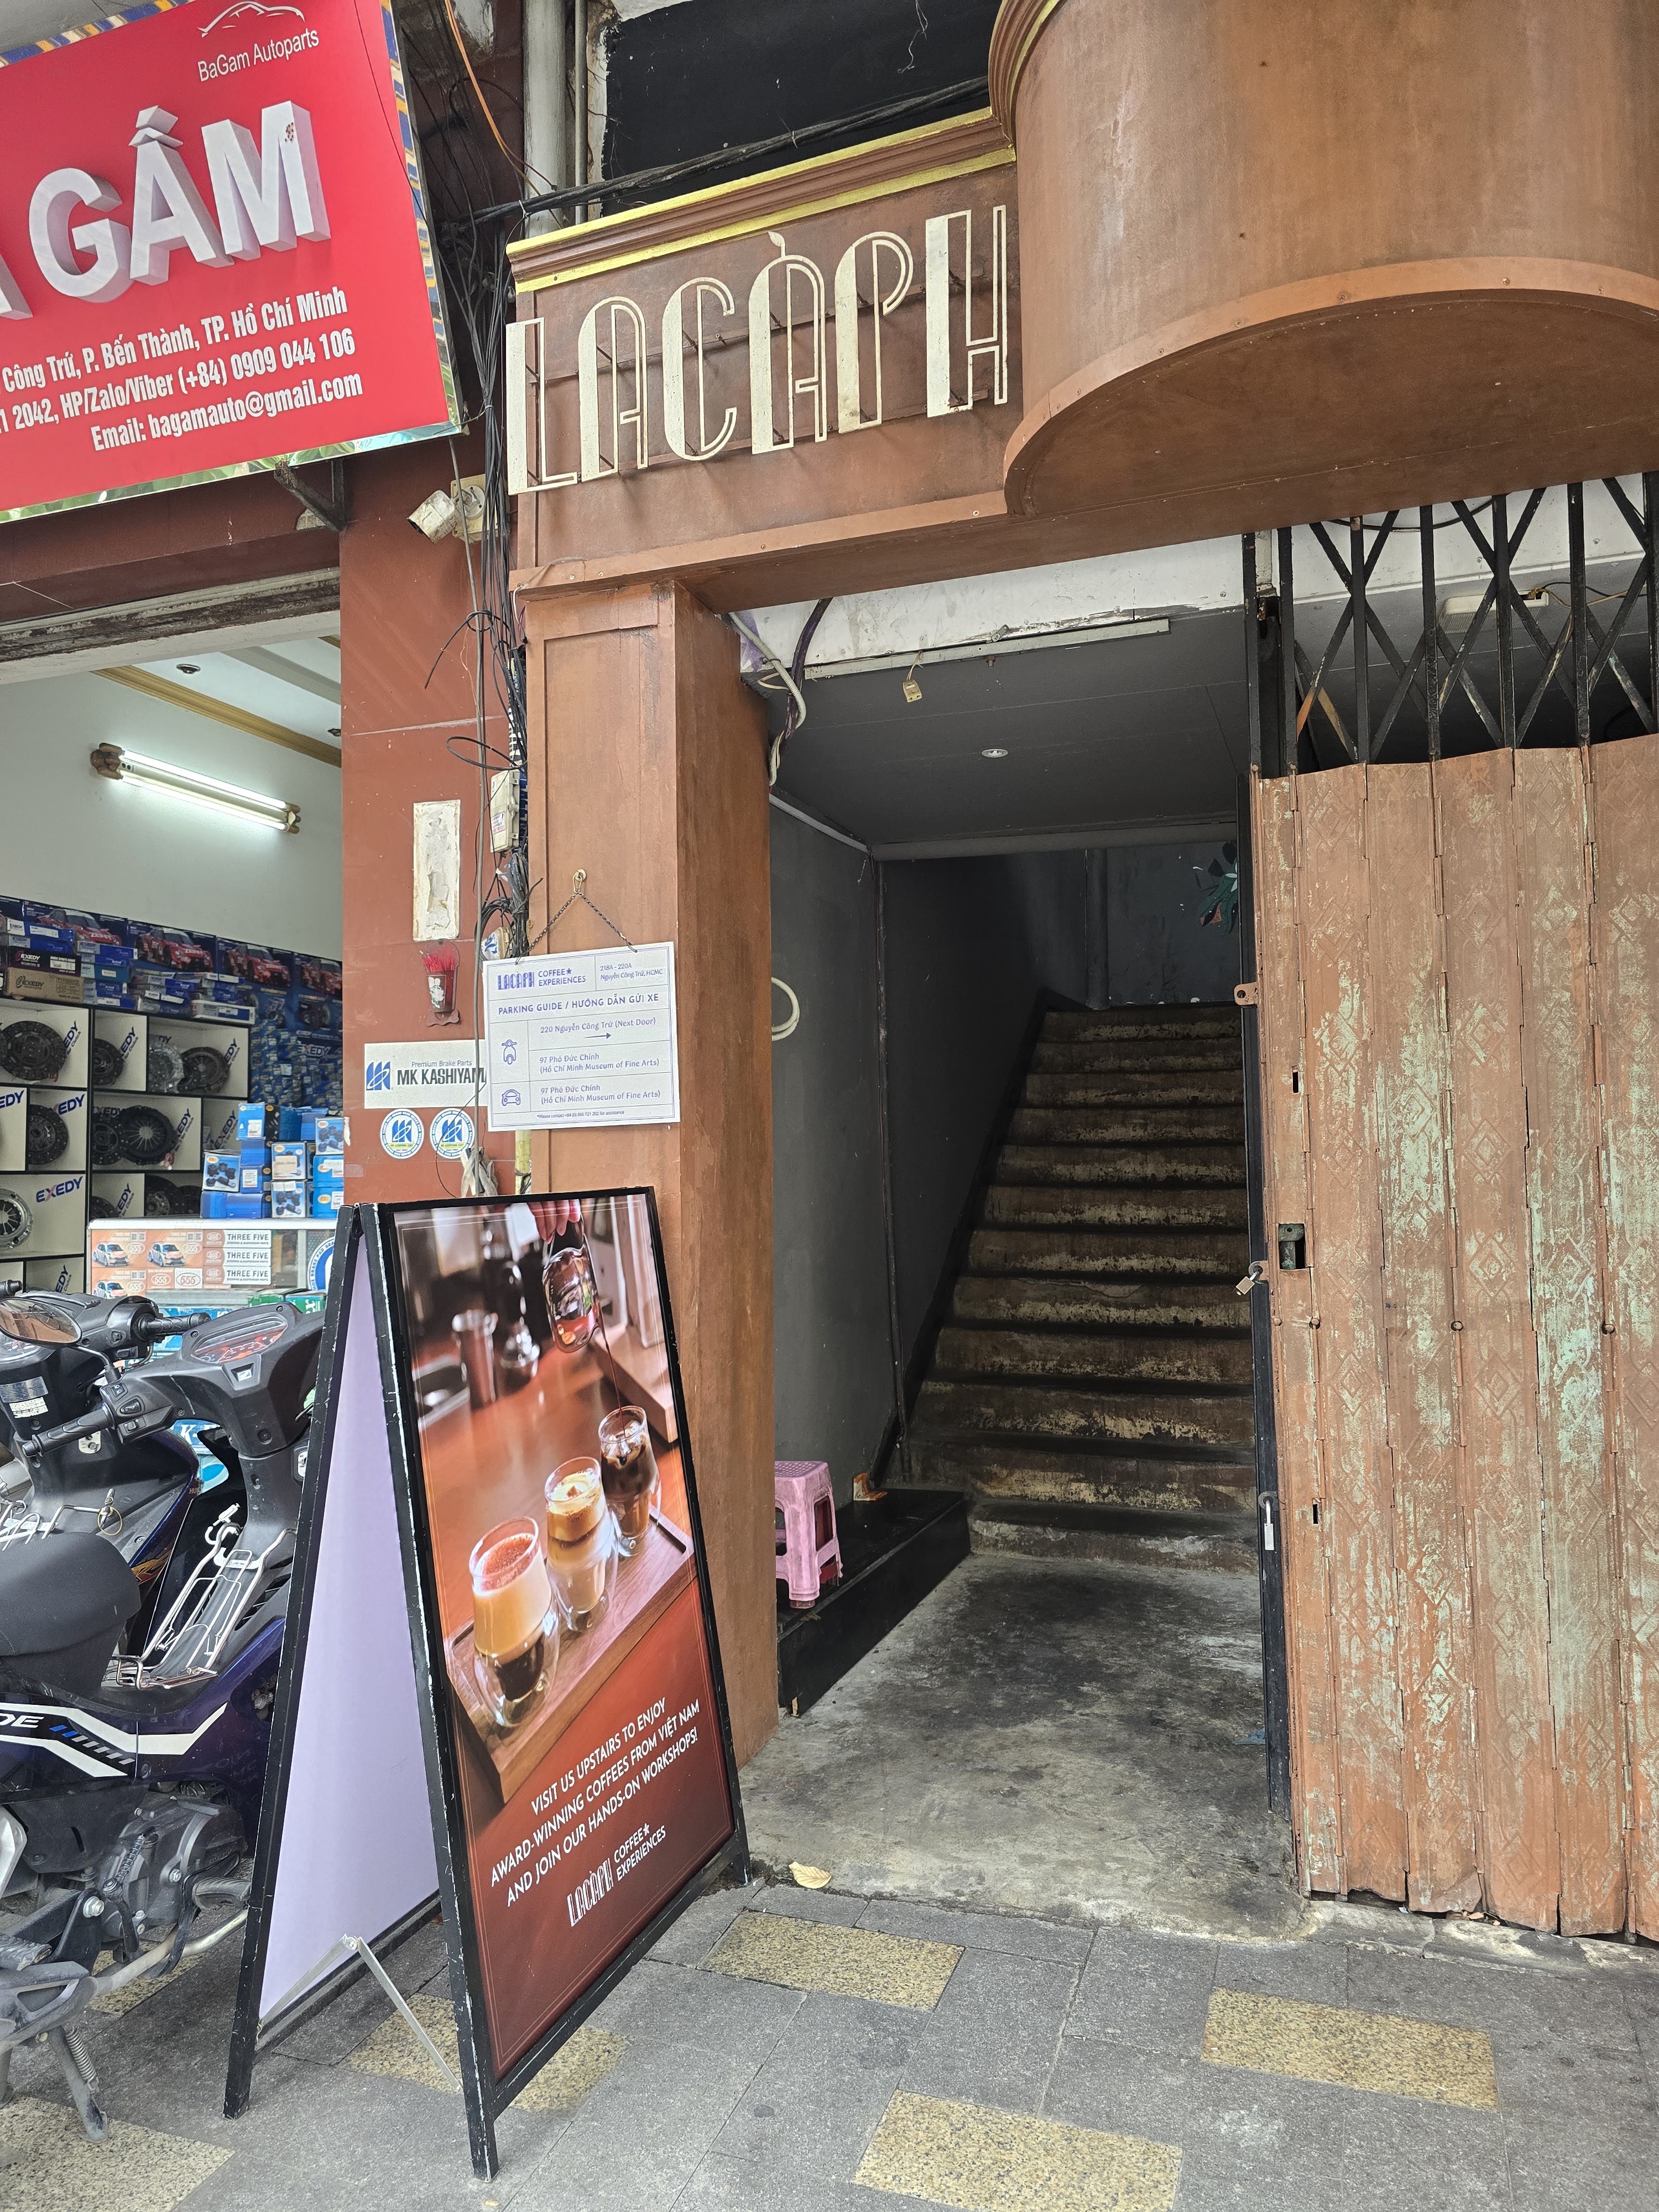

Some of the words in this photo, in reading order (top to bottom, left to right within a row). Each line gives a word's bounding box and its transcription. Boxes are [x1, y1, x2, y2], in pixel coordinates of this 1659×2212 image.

[197, 52, 251, 82] BaGam
[253, 27, 319, 65] Autoparts
[1, 364, 46, 393] Công
[46, 352, 81, 382] Trứ,
[82, 347, 100, 374] P.
[100, 333, 137, 369] Bến
[137, 324, 200, 360] Thành,
[200, 315, 229, 345] TP.
[231, 302, 258, 338] Hồ
[261, 297, 294, 331] Chí
[296, 286, 348, 323] Minh
[12, 398, 59, 429] 2042,
[59, 373, 174, 419] HP/Zalo/Viber
[178, 357, 228, 394] (+84)
[230, 346, 276, 380] 0909
[279, 338, 316, 368] 044
[319, 328, 356, 360] 106
[90, 417, 147, 451] Email:
[147, 373, 363, 439] bagamauto@gmail.com
[20, 952, 41, 961] EXEDY
[22, 979, 45, 988] EXEDY
[538, 968, 566, 978] COFFEE
[539, 975, 586, 987] EXPERIENCES
[498, 1004, 534, 1015] PARKING
[536, 1002, 562, 1011] GUIDE
[565, 1001, 568, 1009] /
[607, 993, 625, 1005] DẪN
[648, 993, 659, 1002] XE
[62, 1020, 79, 1048] EDY
[581, 1022, 599, 1031] Công
[601, 1021, 613, 1029] Trứ
[615, 1020, 634, 1029] (Next
[635, 1016, 656, 1026] Door)
[120, 1026, 137, 1053] EDY
[554, 1065, 565, 1073] Chí
[566, 1063, 583, 1072] Minh
[585, 1062, 614, 1071] Museum
[615, 1060, 624, 1068] of
[625, 1060, 640, 1068] Fine
[641, 1058, 660, 1067] Arts)
[564, 1053, 578, 1062] Đức
[580, 1052, 599, 1061] Chính
[397, 1069, 418, 1085] MK
[421, 1067, 487, 1084] KASHIYAM
[0, 1090, 24, 1108] EDY
[554, 1095, 566, 1104] Chí
[567, 1094, 585, 1103] Minh
[586, 1093, 615, 1102] Museum
[617, 1092, 625, 1100] of
[626, 1091, 641, 1099] Fine
[643, 1089, 661, 1098] Arts)
[565, 1084, 579, 1093] Đức
[581, 1084, 601, 1092] Chính
[58, 1094, 85, 1115] EDY
[177, 1108, 191, 1134] EDY
[36, 1176, 84, 1203] EXEDY
[117, 1182, 132, 1211] EDY
[316, 1248, 325, 1258] PAD
[56, 1264, 69, 1293] EDY
[154, 1276, 168, 1284] 555
[180, 1275, 196, 1285] 555
[531, 1782, 558, 1816] VISIT
[560, 1770, 575, 1792] US
[576, 1733, 621, 1779] UPSTAIRS
[622, 1722, 635, 1742] TO
[637, 1697, 665, 1731] ENJOY
[491, 1793, 585, 1887] AWARD-WINNING
[586, 1755, 629, 1802] COFFEES
[630, 1732, 658, 1766] FROM
[658, 1715, 677, 1741] VIỆT
[679, 1698, 700, 1726] NAM
[508, 1871, 533, 1907] AND
[535, 1844, 561, 1885] JOIN
[563, 1823, 587, 1854] OUR
[588, 1775, 640, 1833] HANDS-ON
[641, 1726, 698, 1785] WORKSHOPS!
[614, 1827, 644, 1863] COFFEE
[616, 1825, 666, 1881] EXPERIENCES
